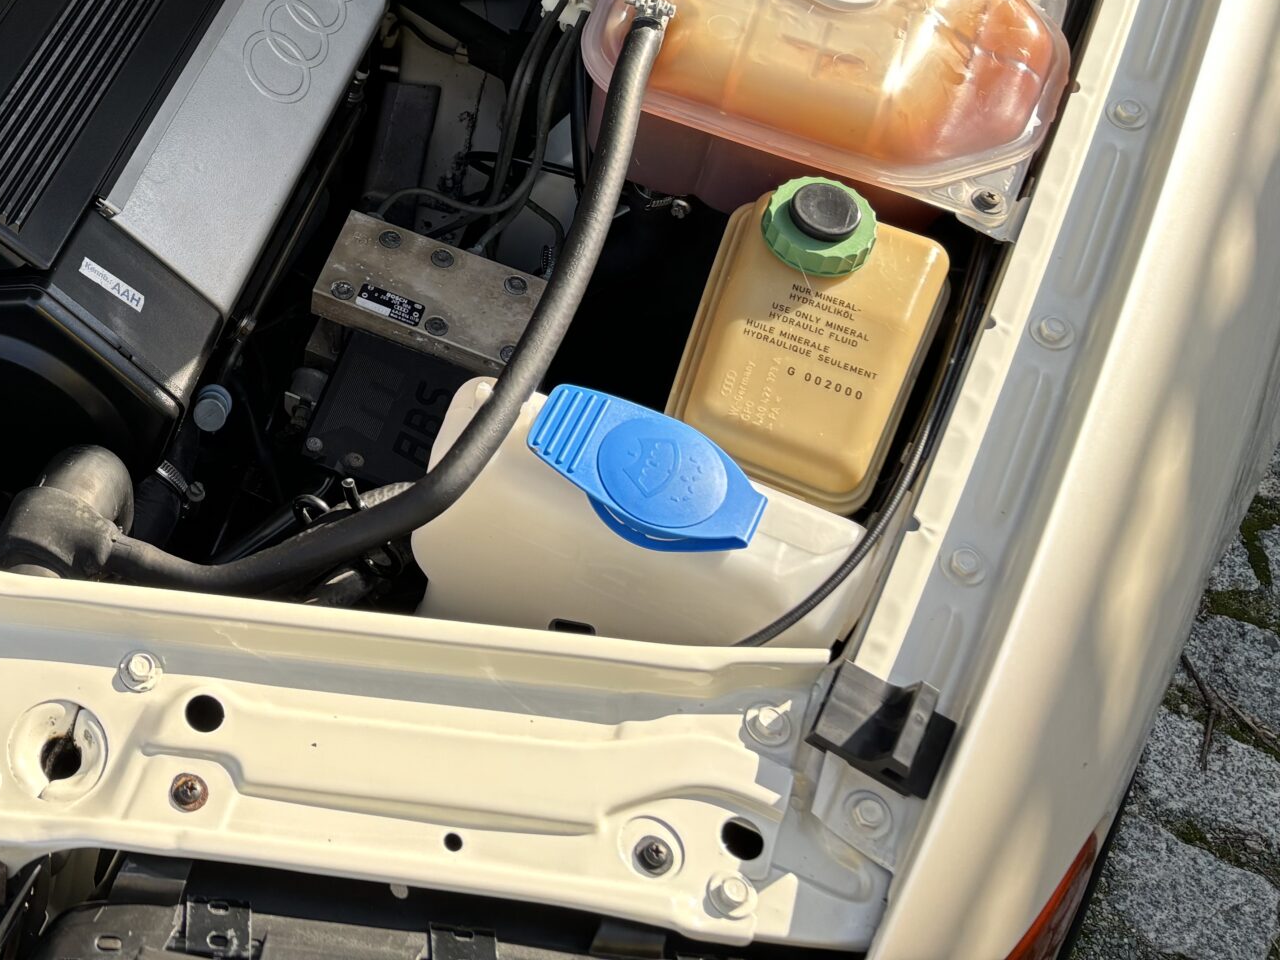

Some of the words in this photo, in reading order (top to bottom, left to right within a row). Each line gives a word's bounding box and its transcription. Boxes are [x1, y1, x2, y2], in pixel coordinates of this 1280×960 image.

[111, 282, 142, 306] AAH
[386, 293, 407, 303] BOSCH
[788, 293, 856, 320] HYDRAULIKÖL
[792, 284, 811, 295] NUR
[814, 292, 862, 312] MINERAL-
[746, 319, 775, 333] HUILE
[778, 331, 830, 353] MINERALE
[768, 312, 824, 335] HYDRAULIC
[828, 332, 858, 347] FLUID
[771, 302, 790, 314] USE
[794, 310, 821, 324] ONLY
[825, 321, 870, 340] MINERAL
[742, 329, 812, 356] HYDRAULIQUE
[817, 355, 877, 379] SEULEMENT
[787, 367, 795, 376] G
[803, 373, 863, 399] 002000
[392, 380, 454, 471] ABS
